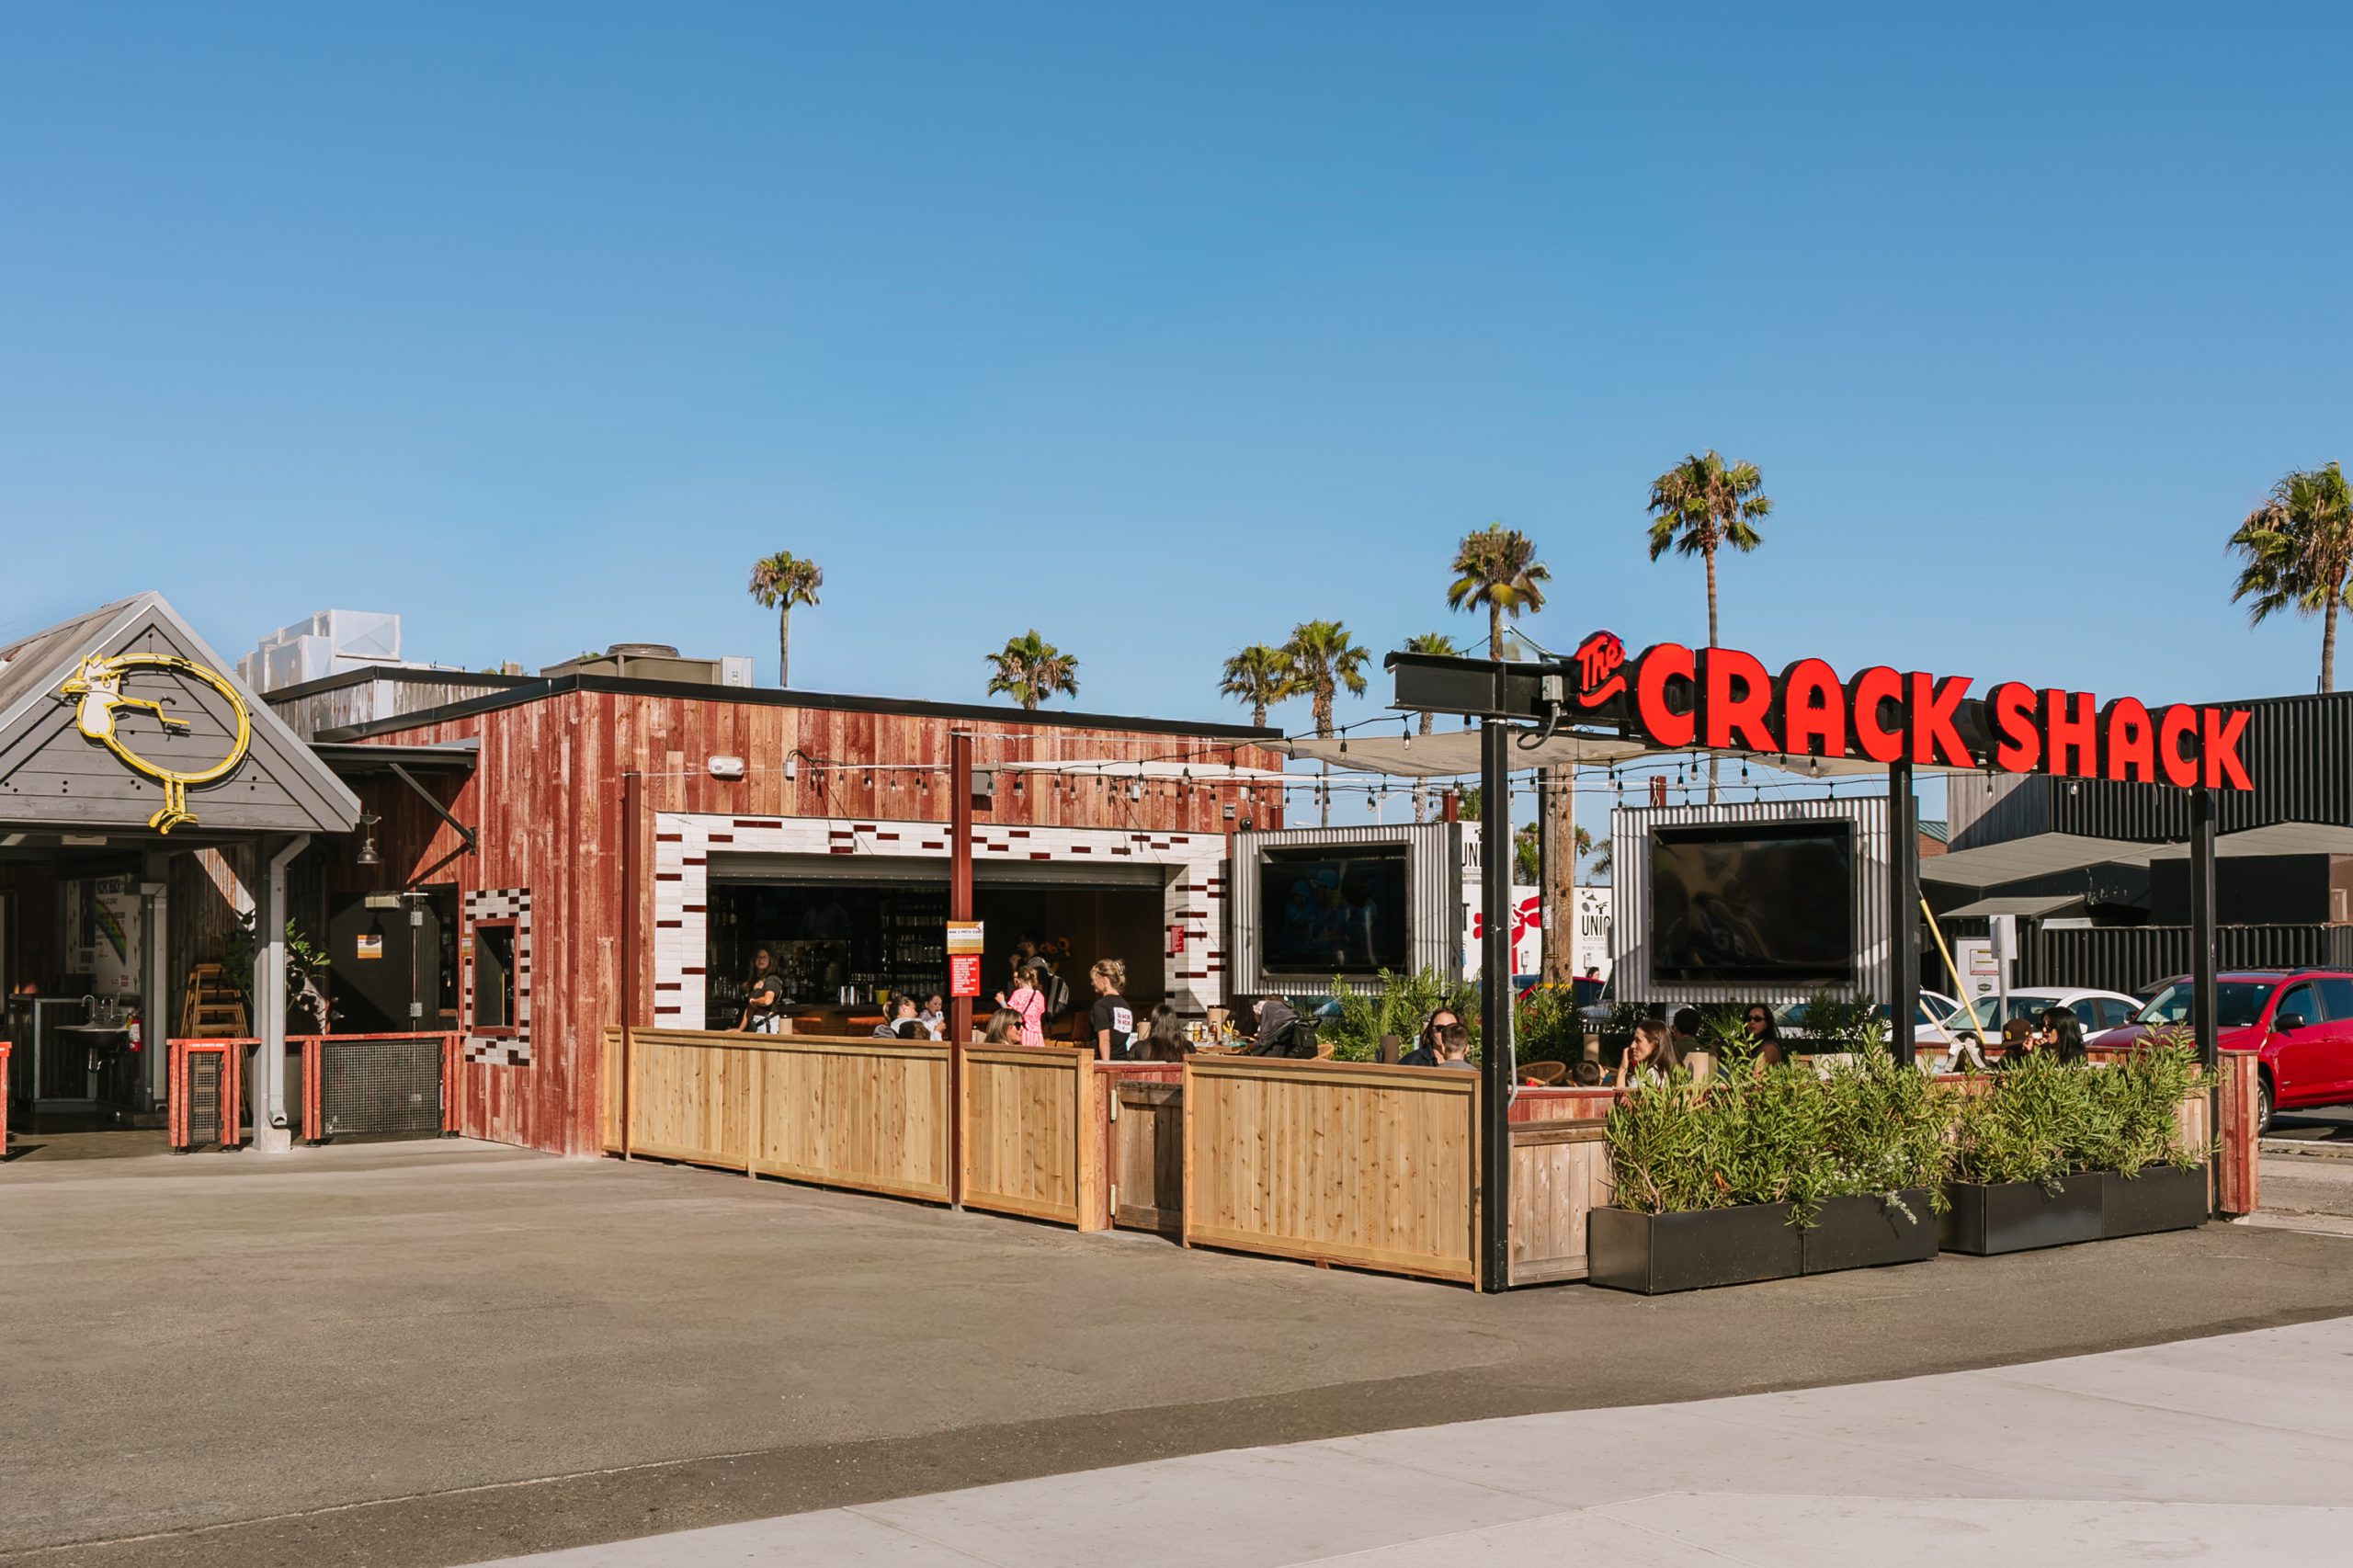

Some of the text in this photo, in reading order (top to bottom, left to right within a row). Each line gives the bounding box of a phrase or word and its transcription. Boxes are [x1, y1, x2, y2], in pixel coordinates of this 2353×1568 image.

[1574, 635, 2254, 791] The CRACK SHACK
